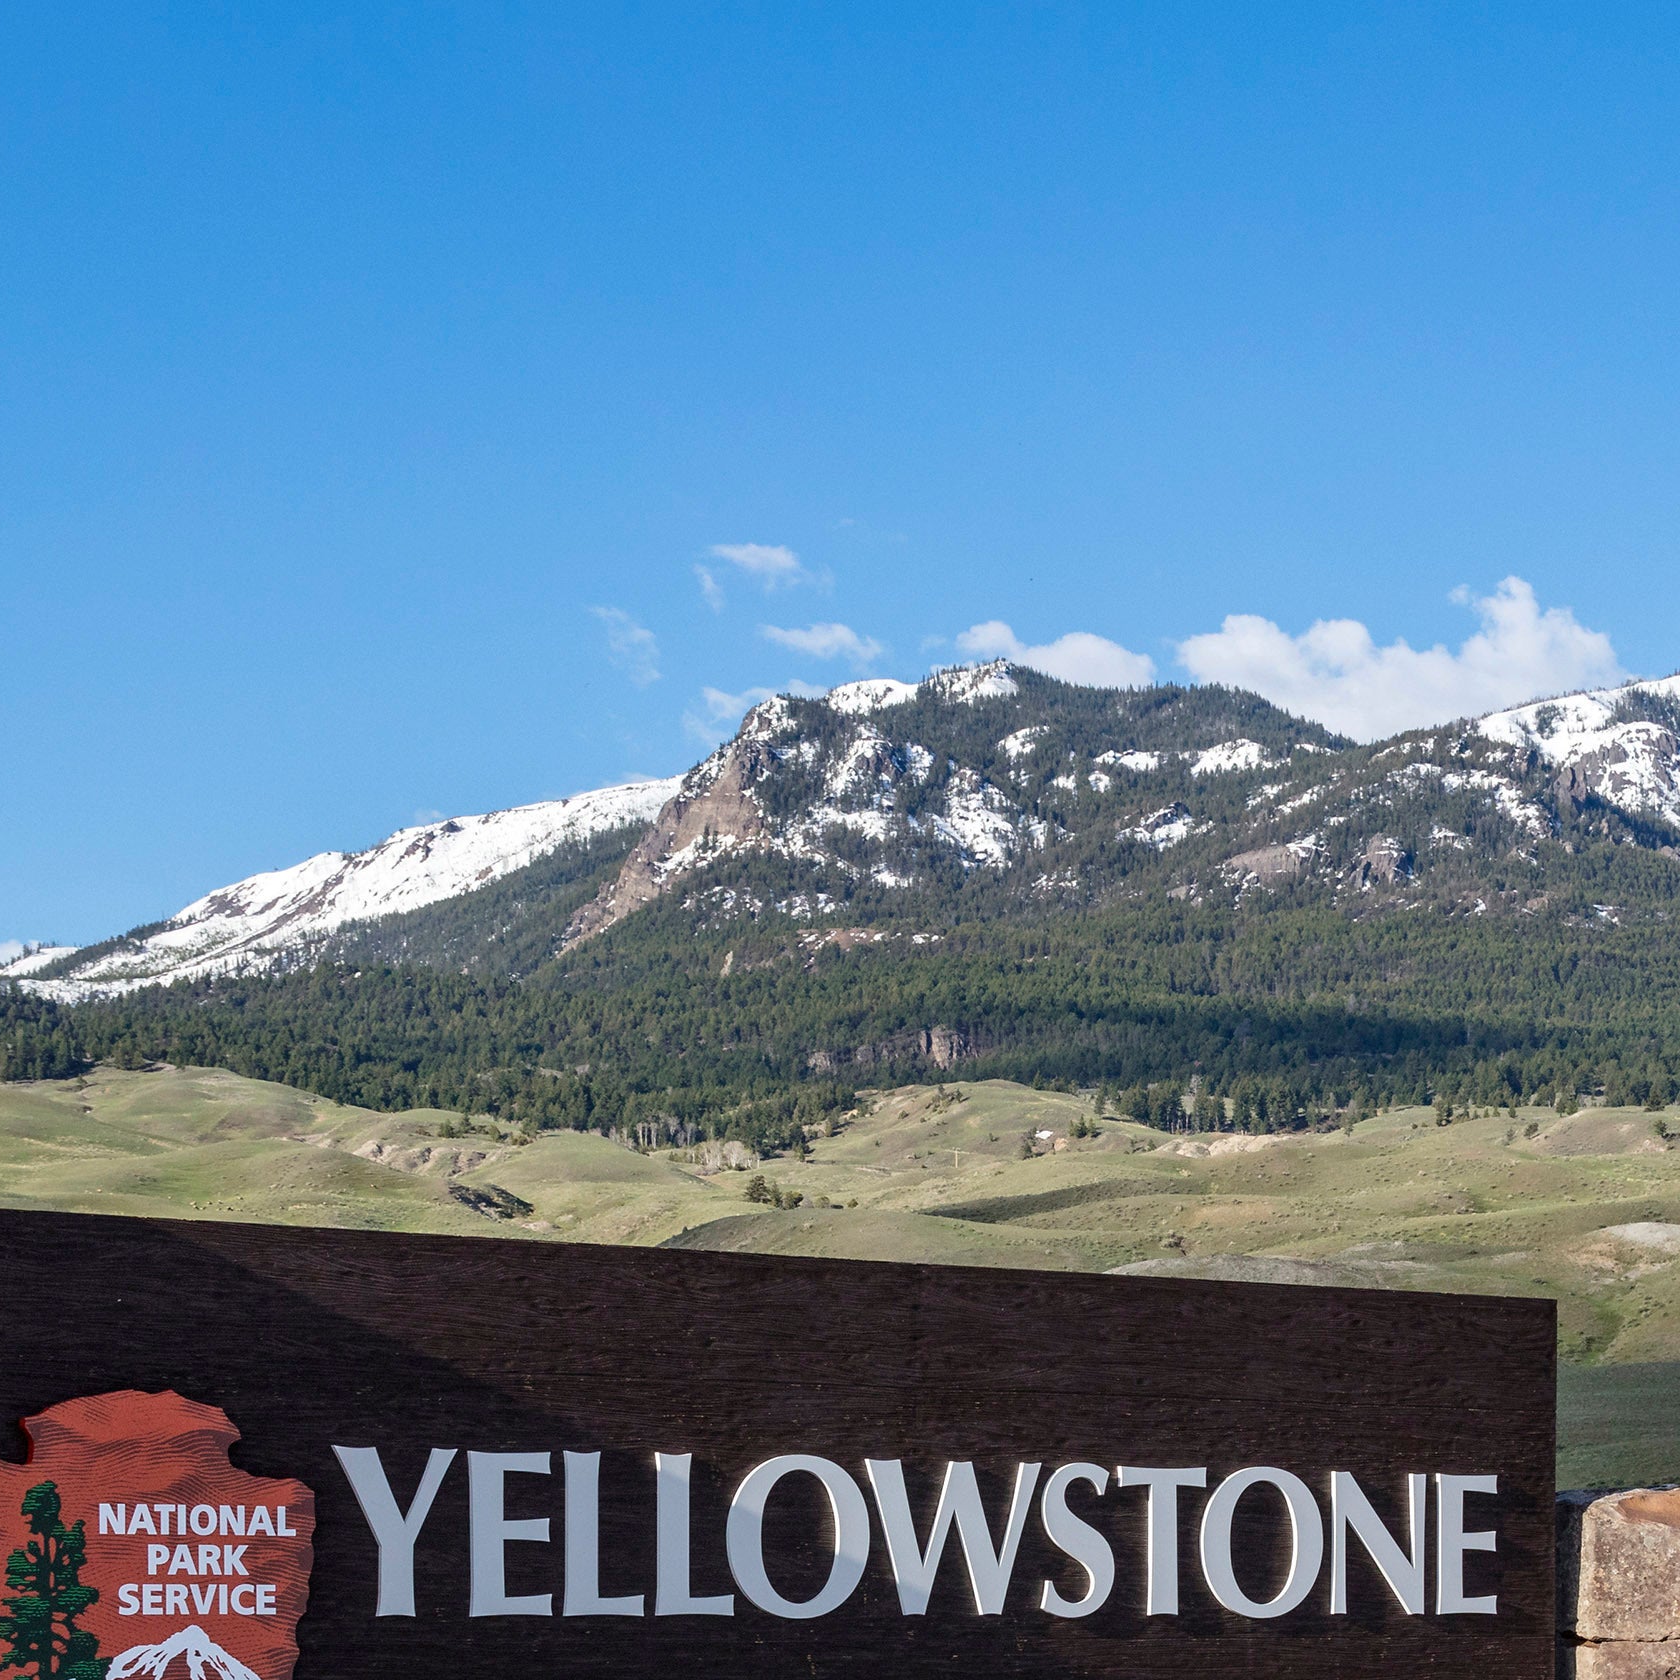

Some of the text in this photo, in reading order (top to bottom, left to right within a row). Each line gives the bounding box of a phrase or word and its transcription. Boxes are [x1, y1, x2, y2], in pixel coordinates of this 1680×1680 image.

[99, 1503, 296, 1536] NATIONAL
[331, 1445, 1497, 1618] YELLOWSTONE
[148, 1544, 249, 1575] PARK
[118, 1583, 276, 1615] SERVICE
